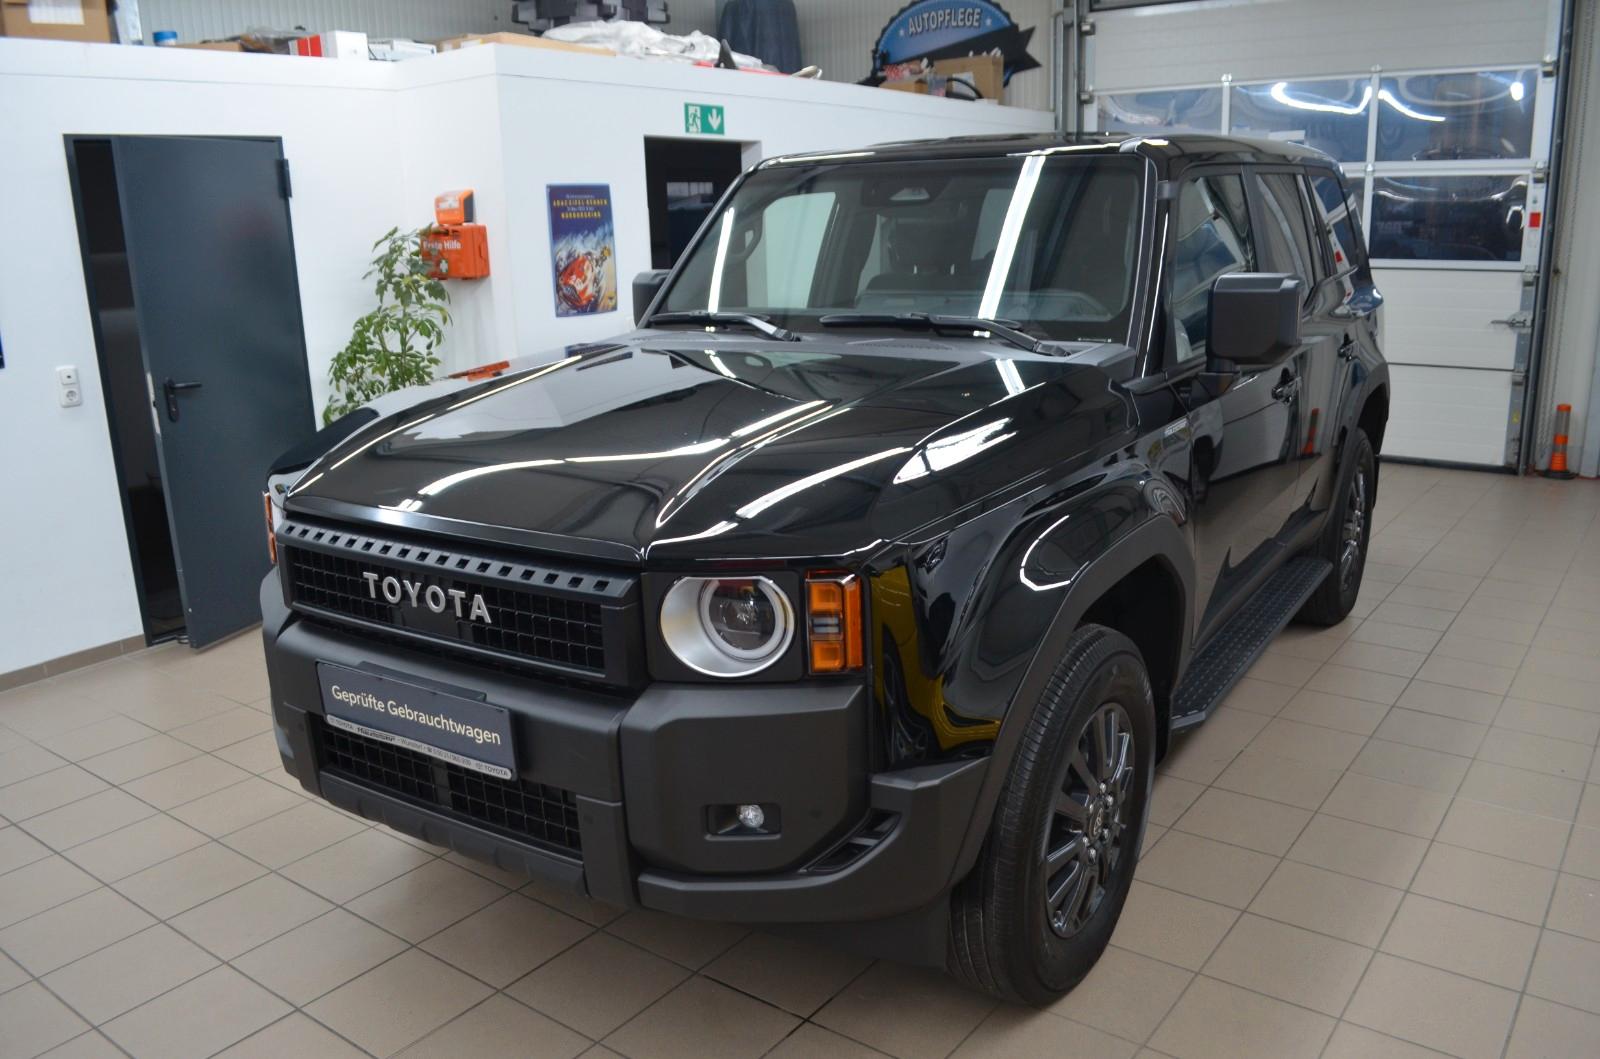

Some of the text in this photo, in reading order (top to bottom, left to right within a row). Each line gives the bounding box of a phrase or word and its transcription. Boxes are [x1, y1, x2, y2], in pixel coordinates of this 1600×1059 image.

[908, 7, 981, 35] AUTOPFLEGE
[444, 240, 461, 249] Hilfe
[363, 571, 492, 624] TOYOTA
[331, 685, 385, 713] Geprüfte
[387, 700, 501, 745] Gebrauchtwagen
